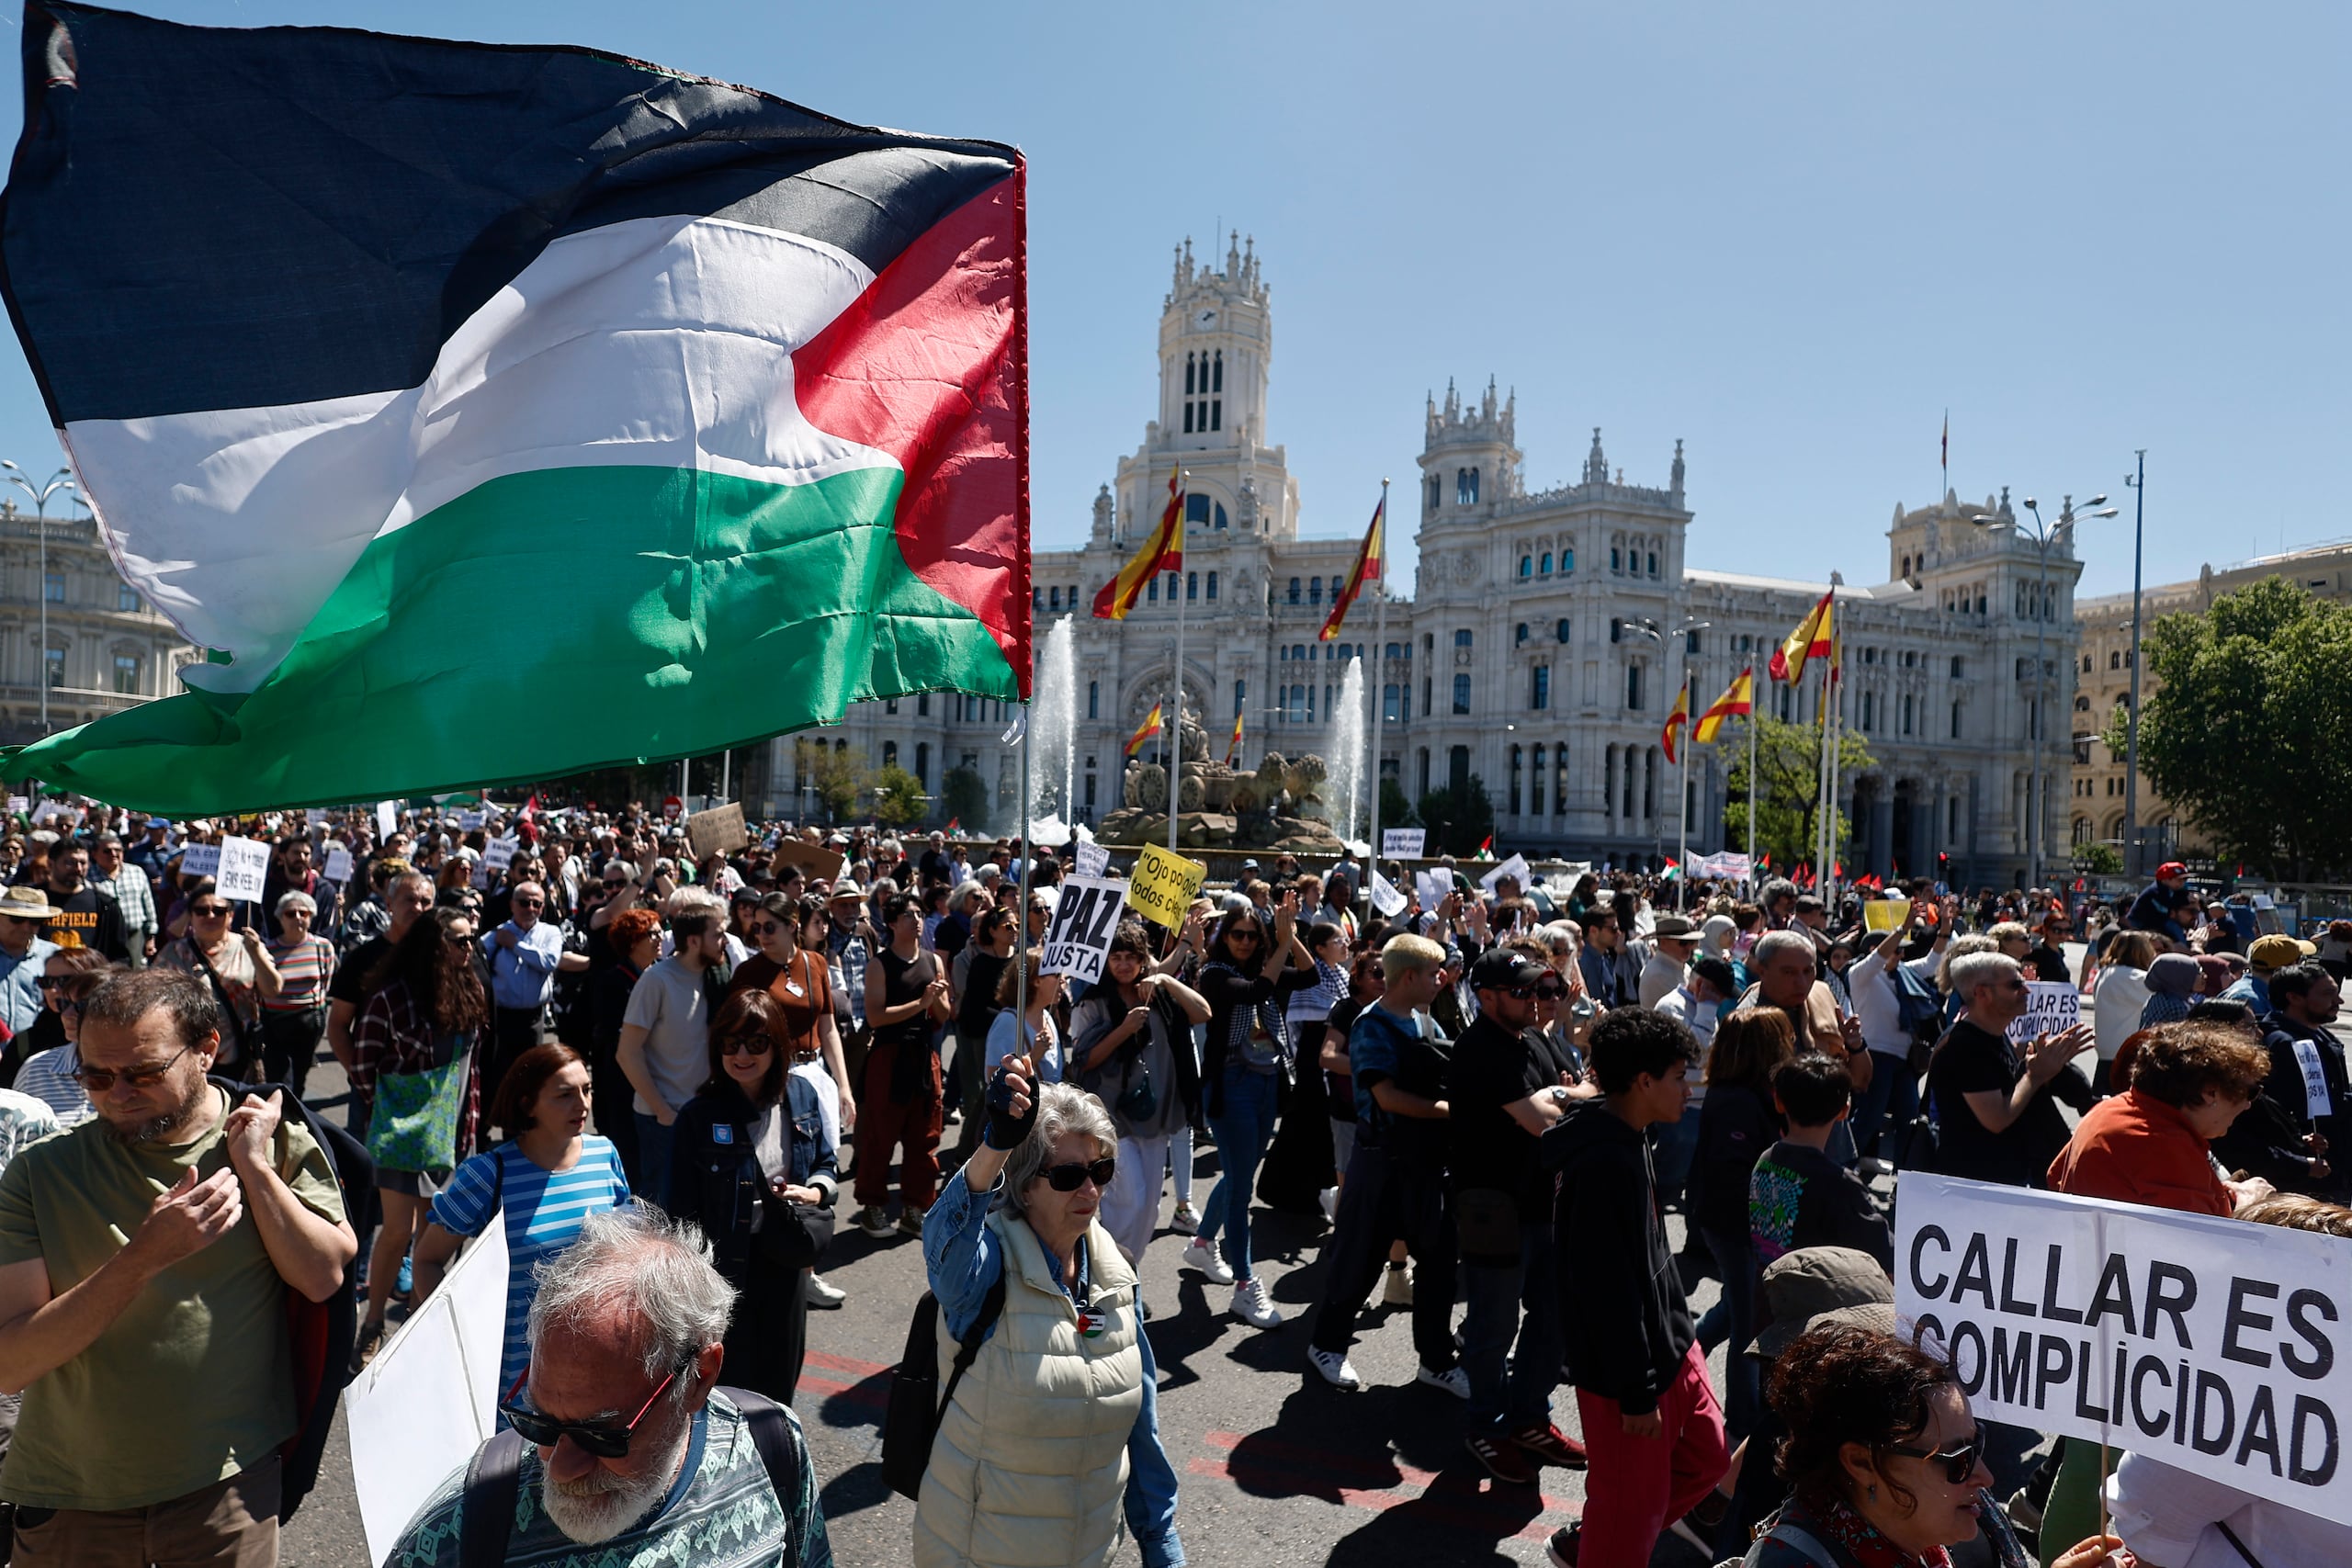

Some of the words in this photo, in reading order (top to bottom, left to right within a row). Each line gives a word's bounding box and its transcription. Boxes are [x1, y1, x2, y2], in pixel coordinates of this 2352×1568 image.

[1131, 876, 1164, 908] todos
[1048, 884, 1122, 951] PAZ
[1042, 945, 1100, 977] JUSTA
[2059, 995, 2078, 1014] ES
[1910, 1224, 2198, 1350] CALLAR
[2221, 1276, 2338, 1380] ES
